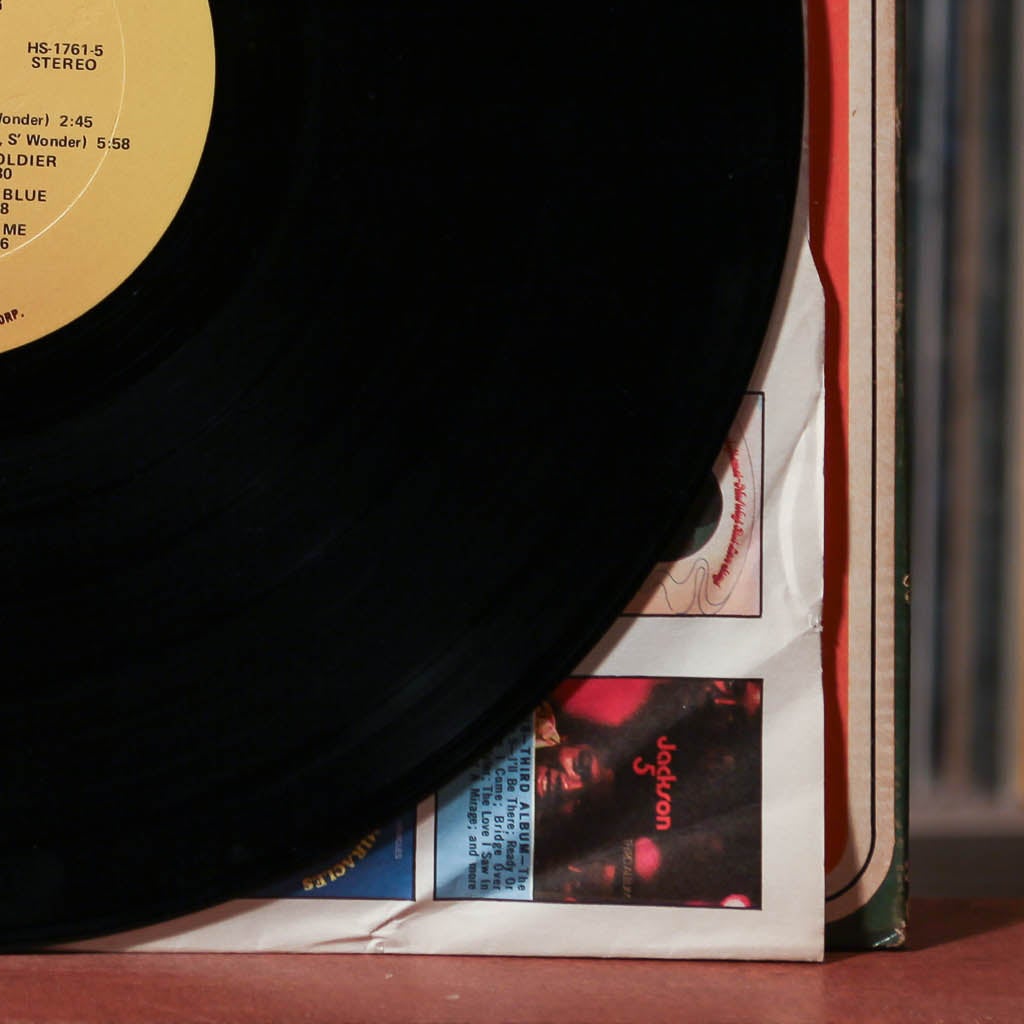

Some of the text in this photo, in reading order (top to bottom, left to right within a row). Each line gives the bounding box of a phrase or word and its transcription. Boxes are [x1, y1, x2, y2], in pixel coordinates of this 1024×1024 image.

[27, 41, 104, 57] HS-1761-5
[31, 56, 97, 71] STEREO
[59, 115, 93, 129] 2:45
[26, 133, 87, 149] Wonder)
[97, 137, 130, 150] 5:58
[3, 188, 47, 202] BLUE
[3, 223, 27, 237] ME
[632, 756, 655, 776] 5
[655, 736, 676, 831] Jackson
[481, 786, 492, 806] The
[481, 810, 492, 837] Love
[490, 766, 506, 892] Come; Bridge Over
[502, 777, 518, 890] Be There; Ready Or
[468, 836, 478, 856] and
[480, 850, 492, 874] Saw
